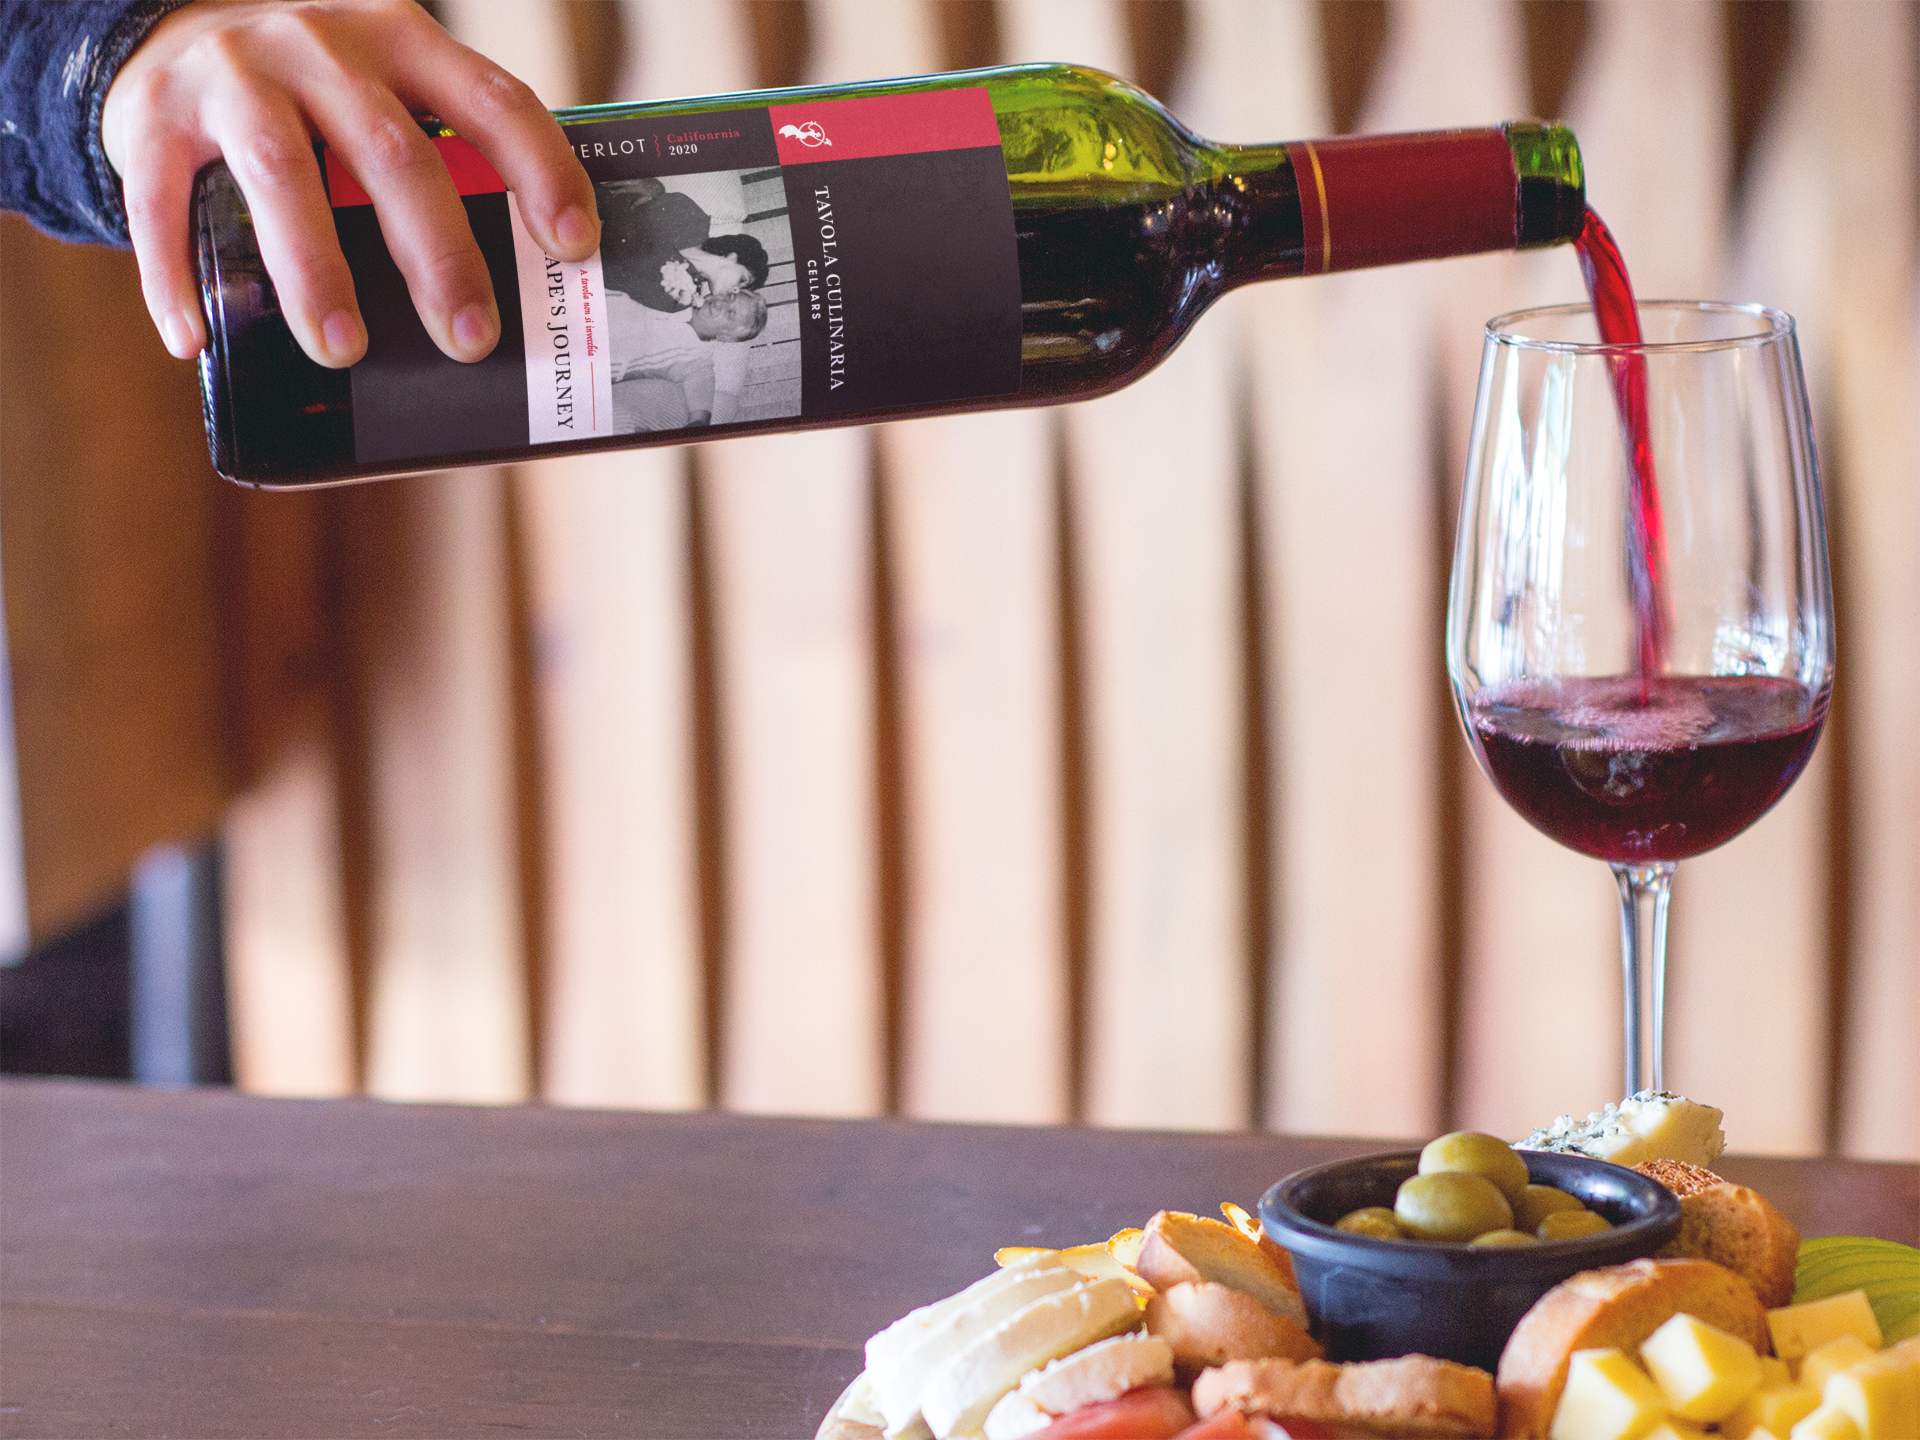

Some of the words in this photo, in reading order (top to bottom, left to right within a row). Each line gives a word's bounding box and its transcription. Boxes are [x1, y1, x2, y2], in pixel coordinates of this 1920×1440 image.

[667, 128, 741, 144] Califonrnia
[569, 138, 646, 159] ERLOT
[669, 143, 698, 156] 2020
[815, 185, 839, 267] TAVOLA
[544, 251, 567, 317] APE'S
[580, 268, 588, 276] A
[581, 277, 594, 301] tavola
[807, 259, 821, 320] CELLARS
[585, 316, 594, 324] si
[826, 273, 845, 391] CULINARIA
[547, 322, 574, 430] JOURNEY
